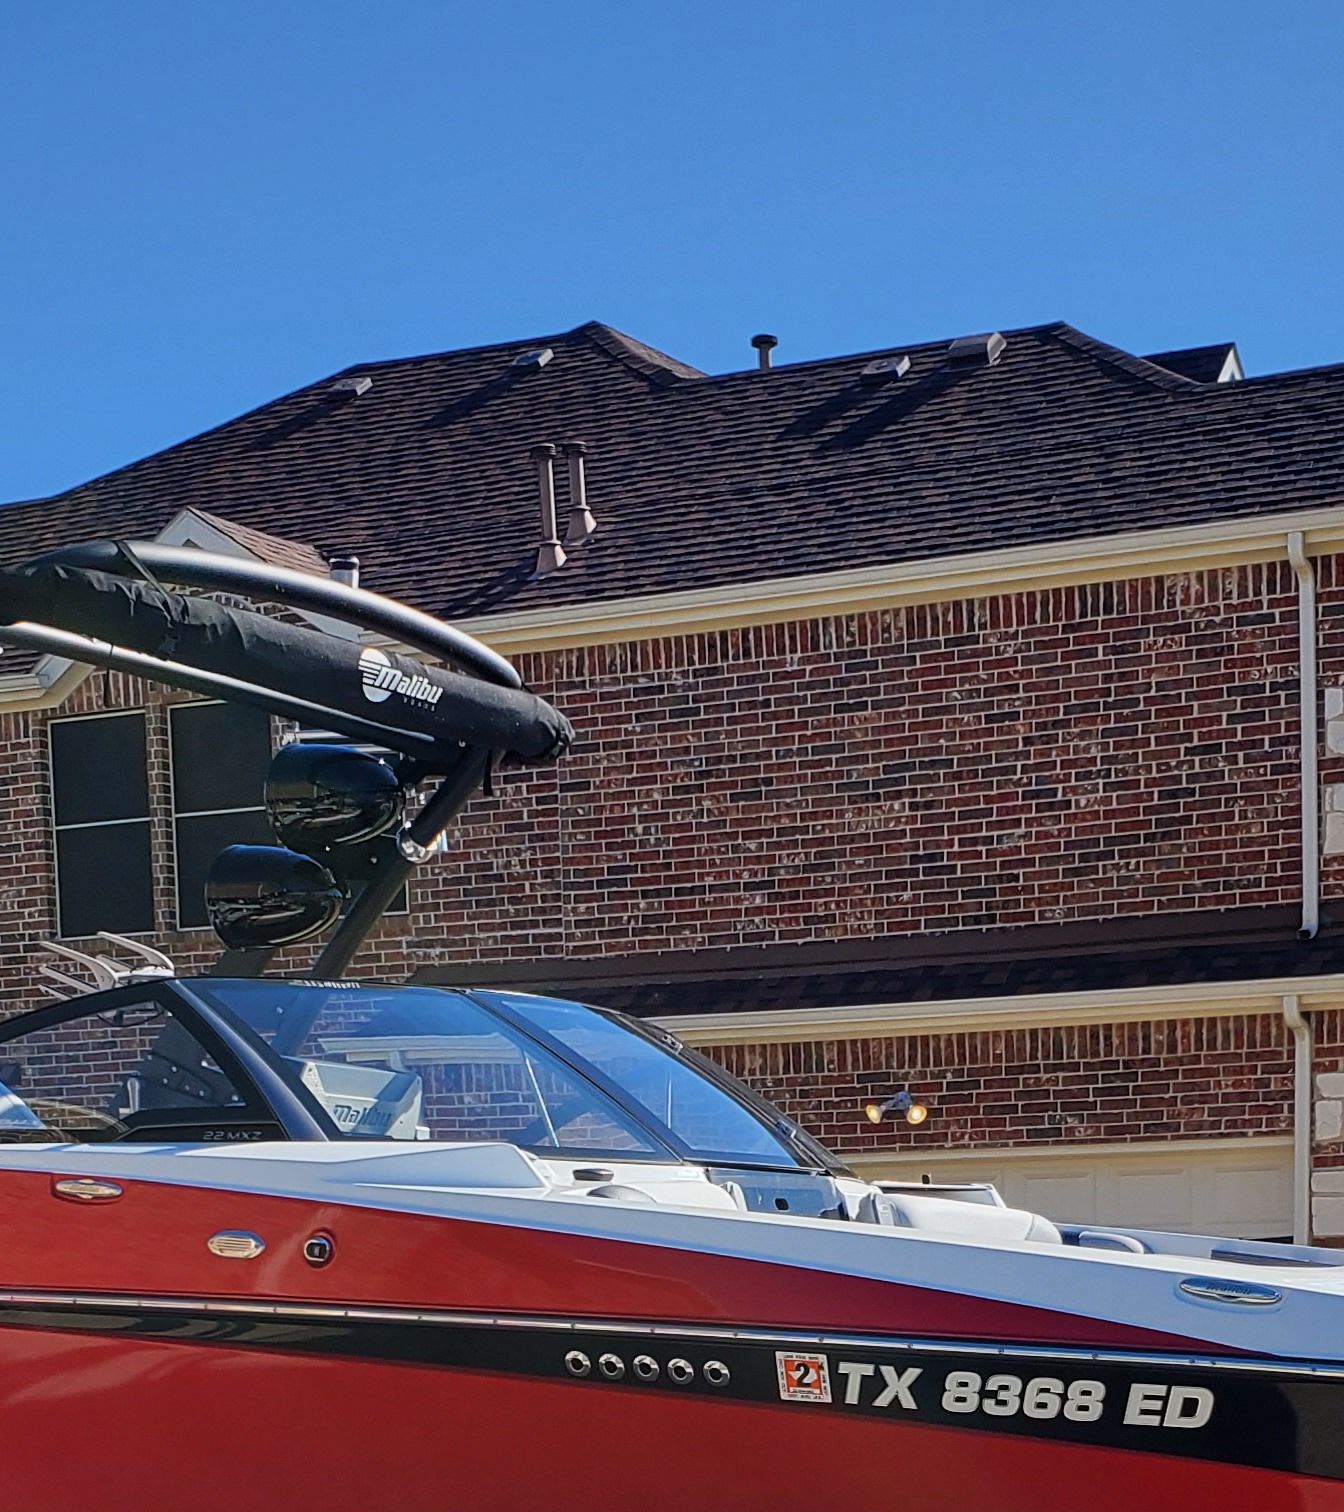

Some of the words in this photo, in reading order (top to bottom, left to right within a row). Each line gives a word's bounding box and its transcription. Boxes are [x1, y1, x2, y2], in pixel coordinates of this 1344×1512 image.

[374, 666, 443, 704] Malibu
[837, 1361, 924, 1410] TX
[941, 1371, 1106, 1422] 8368
[1122, 1383, 1215, 1429] ED
